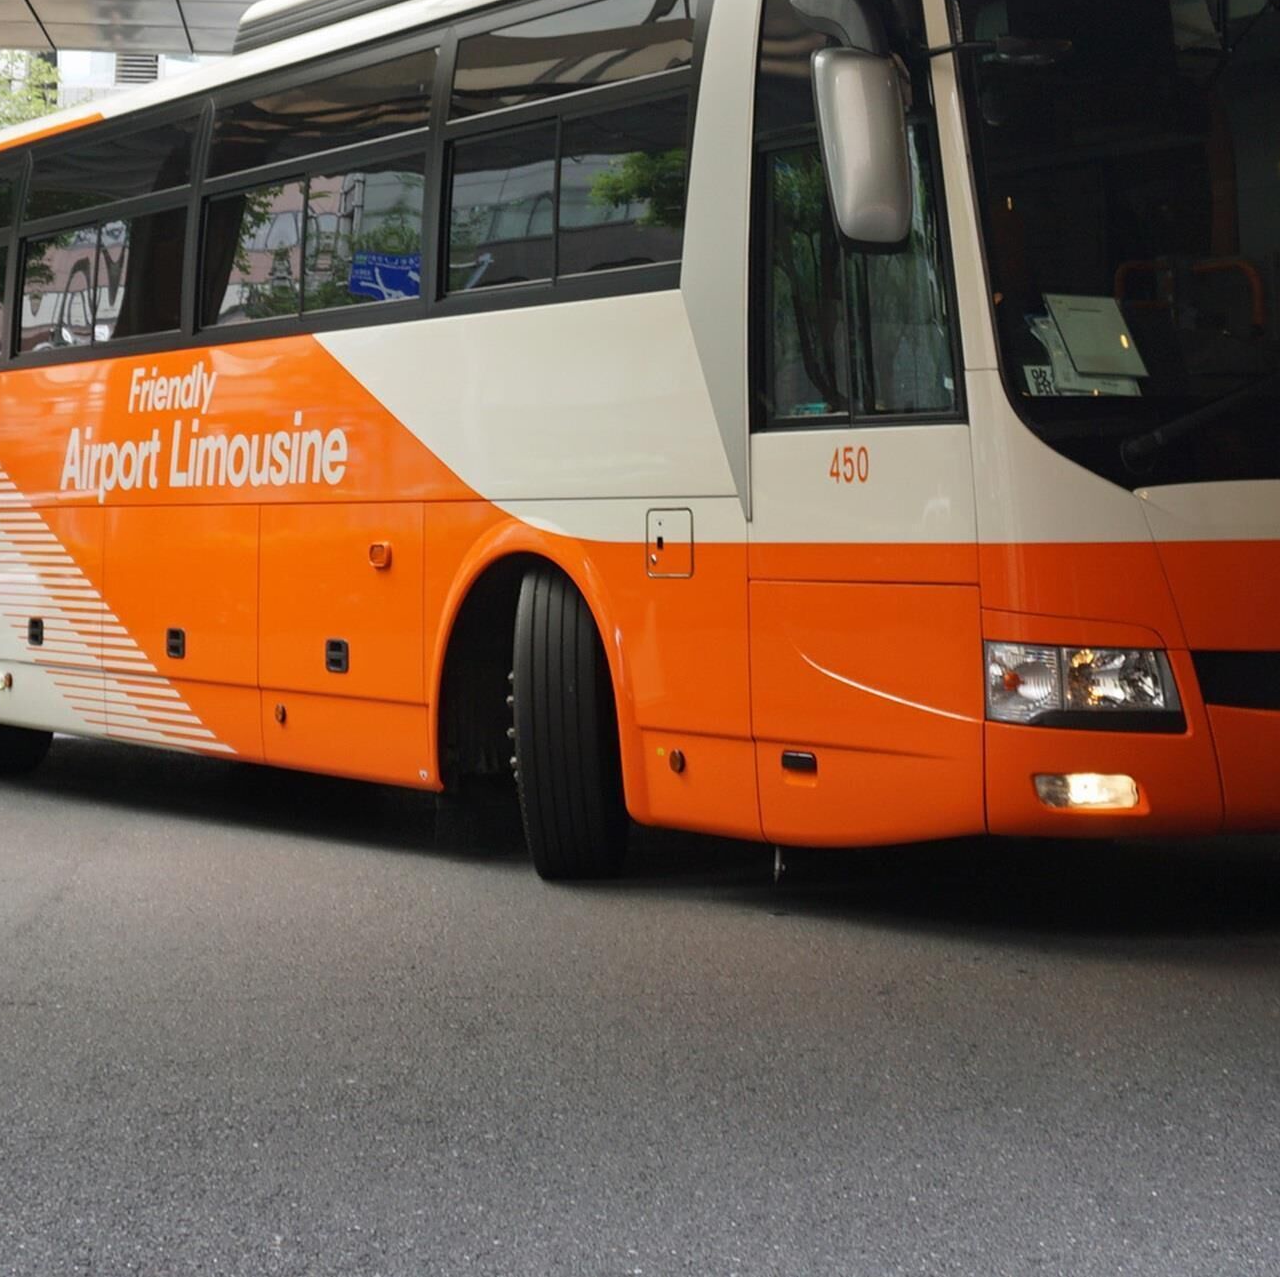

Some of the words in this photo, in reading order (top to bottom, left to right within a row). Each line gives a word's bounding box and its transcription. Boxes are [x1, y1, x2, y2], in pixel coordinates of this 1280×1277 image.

[128, 361, 218, 415] Friendly
[60, 426, 161, 504] Airport
[169, 411, 348, 488] Limousine
[830, 446, 869, 484] 450
